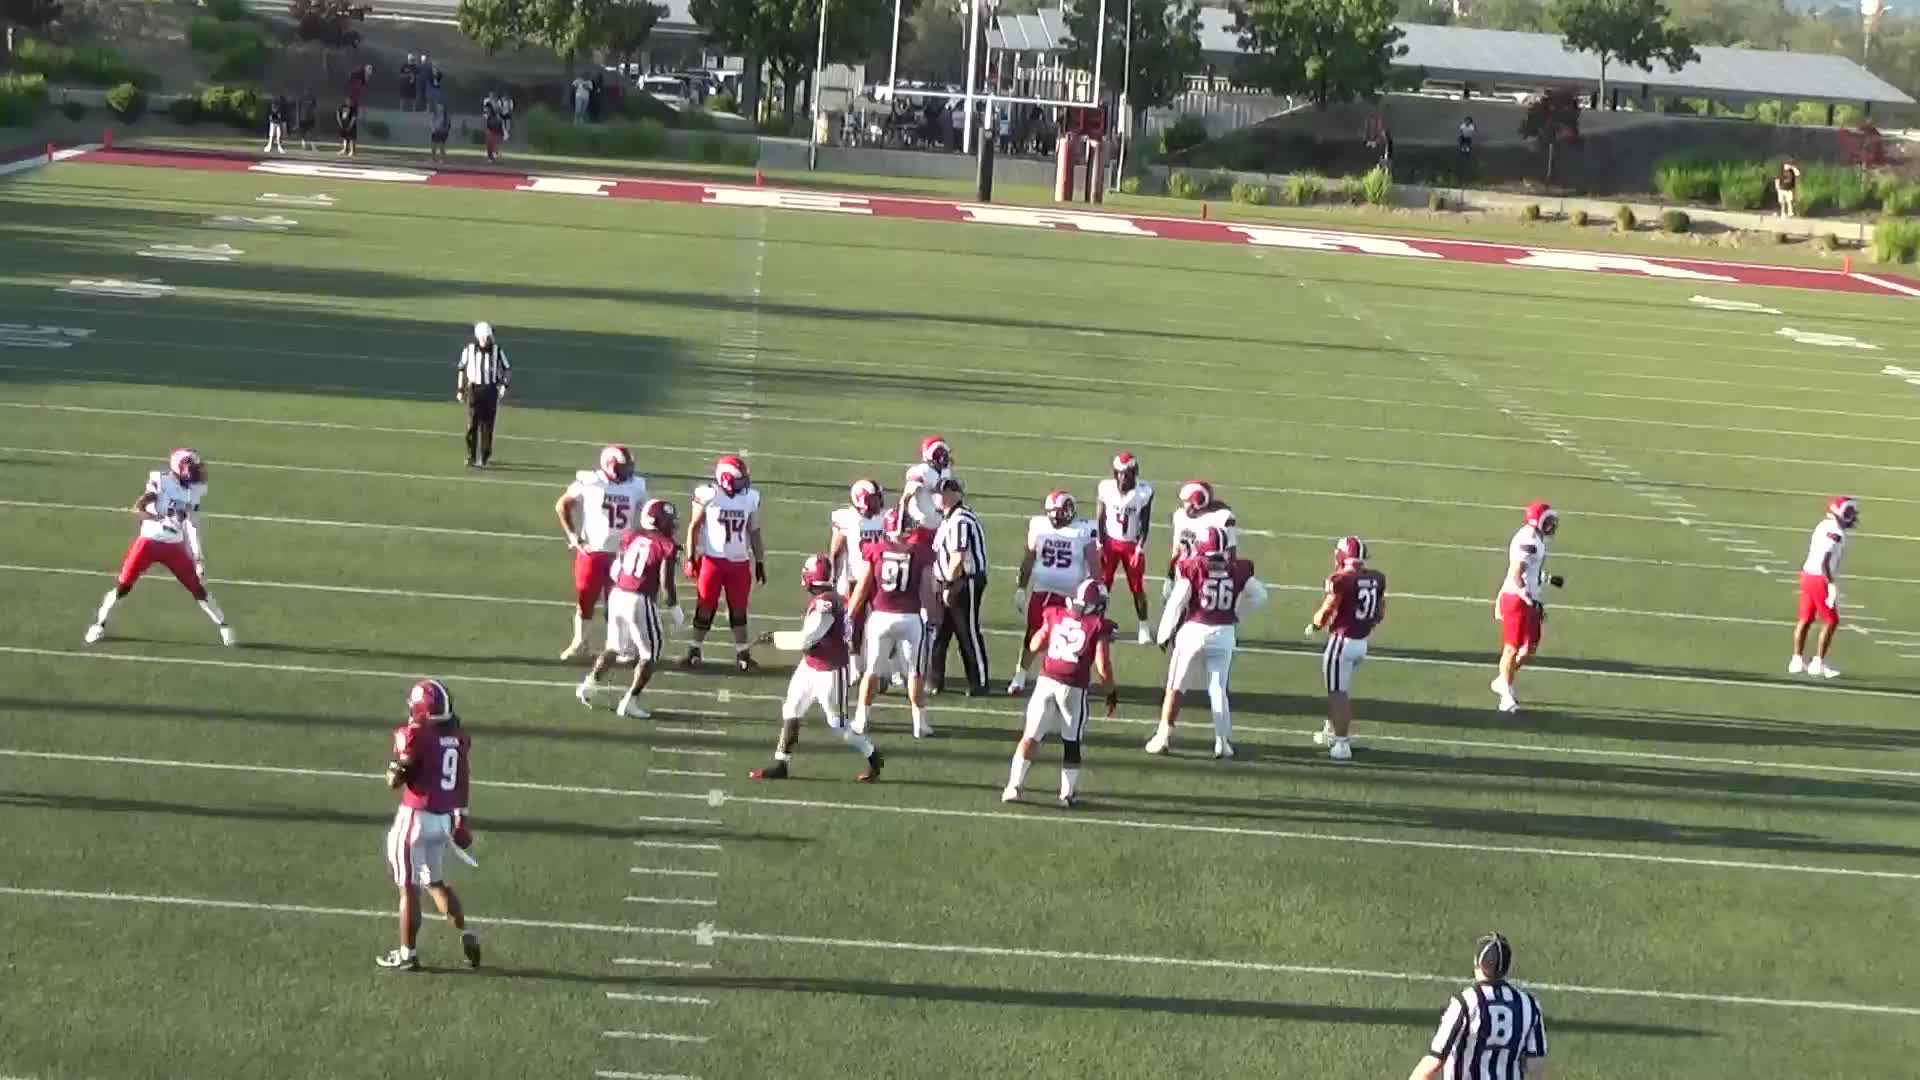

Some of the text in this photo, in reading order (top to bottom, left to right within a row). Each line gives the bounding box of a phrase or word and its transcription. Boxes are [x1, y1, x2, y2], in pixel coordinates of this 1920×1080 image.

[1116, 513, 1129, 536] 4
[1042, 548, 1072, 568] 55
[881, 561, 909, 592] 91
[1201, 579, 1234, 610] 56
[1355, 588, 1378, 619] 31
[440, 748, 458, 791] 9
[1485, 1004, 1514, 1047] B
